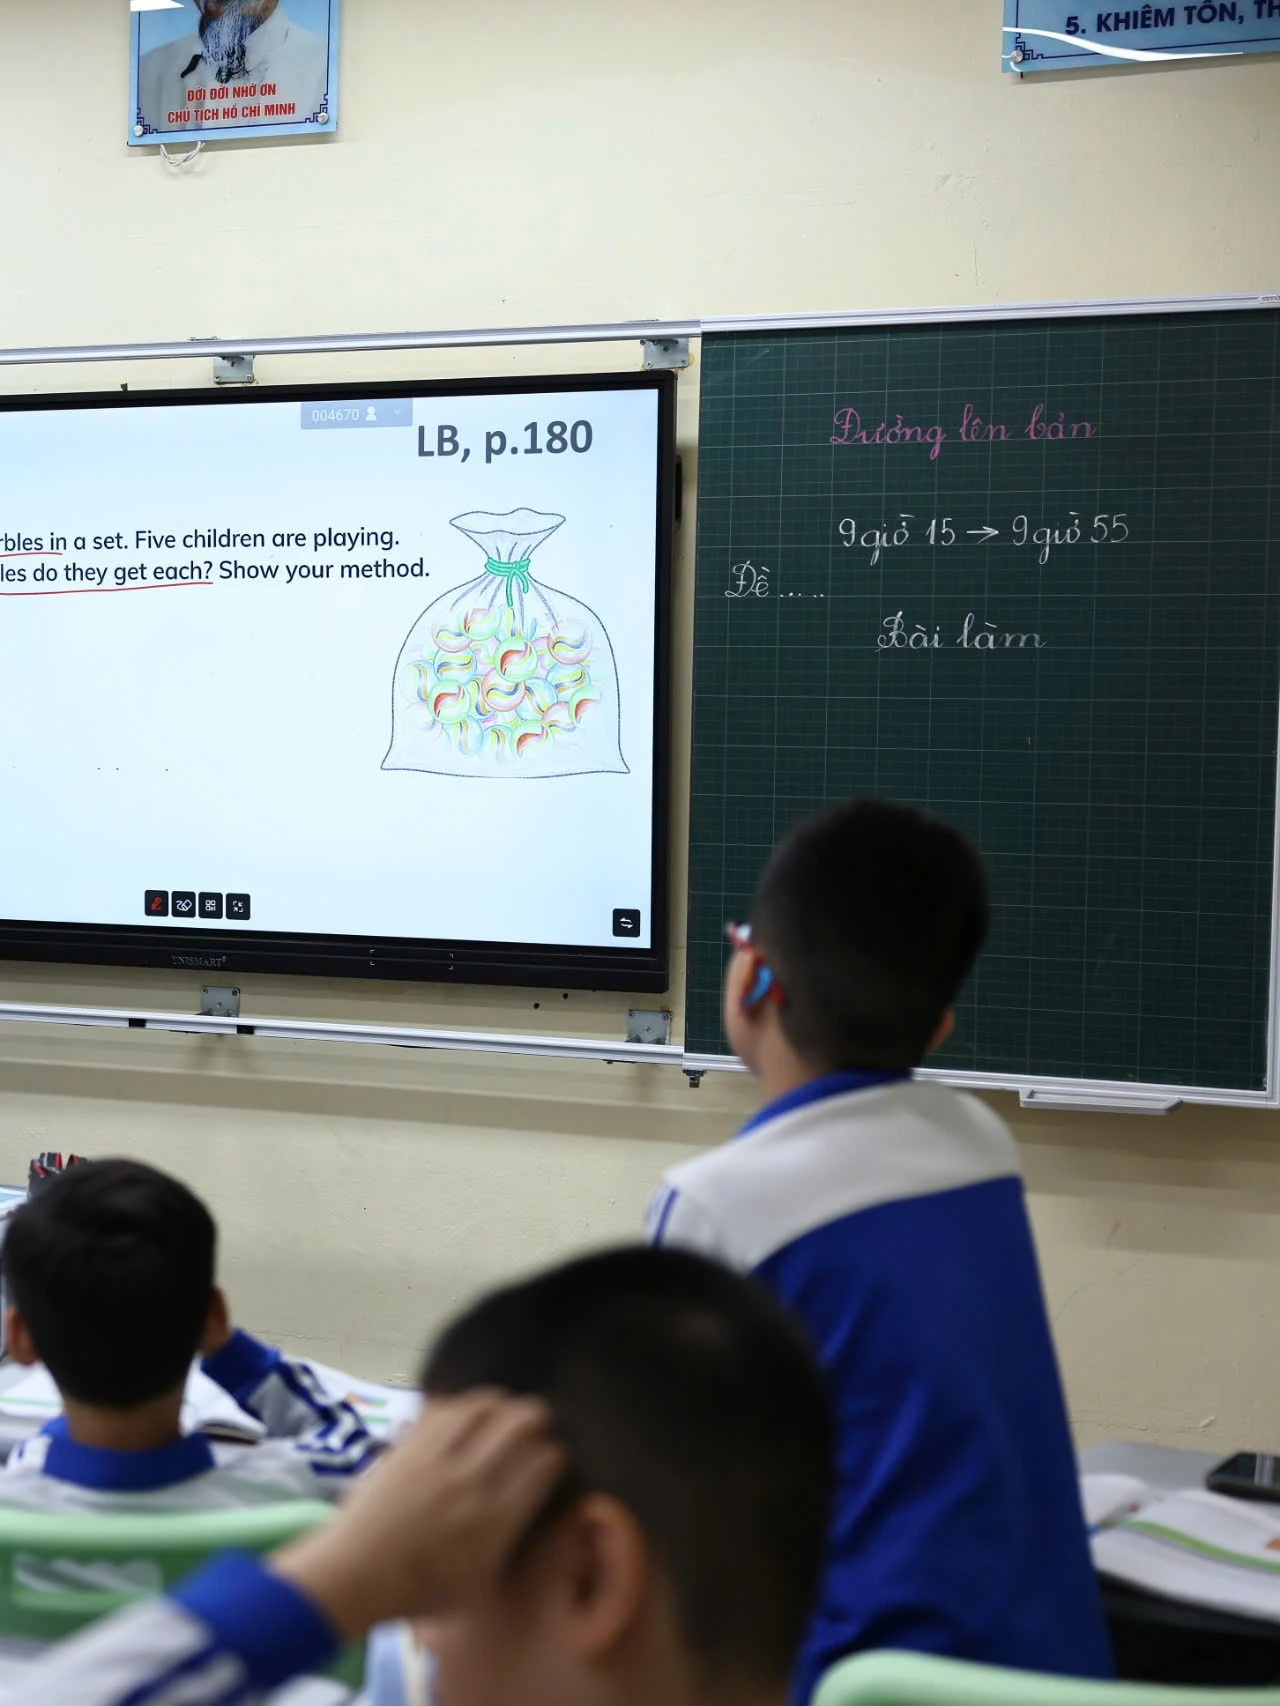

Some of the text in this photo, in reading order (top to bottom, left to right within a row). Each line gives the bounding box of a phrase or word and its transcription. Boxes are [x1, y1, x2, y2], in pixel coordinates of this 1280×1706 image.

[1065, 15, 1086, 35] 5.
[1096, 4, 1175, 33] KHIÊM
[167, 102, 295, 124] CHỦ TỊCH HỒ CHÍ MINH
[312, 408, 360, 422] 004670
[959, 403, 1014, 441] lên
[417, 419, 593, 464] LB, p.180
[50, 532, 67, 551] in
[73, 537, 86, 551] a
[92, 532, 128, 551] set.
[135, 530, 176, 550] Five
[182, 528, 265, 550] children
[272, 532, 307, 548] are
[313, 527, 400, 552] playing.
[925, 517, 956, 546] 15
[1090, 513, 1130, 544] 55
[33, 563, 58, 583] do
[64, 563, 108, 586] they
[114, 563, 147, 586] get
[153, 560, 213, 581] each?
[219, 560, 279, 580] Show
[285, 564, 334, 584] your
[340, 557, 430, 579] method.
[956, 612, 1048, 651] làm
